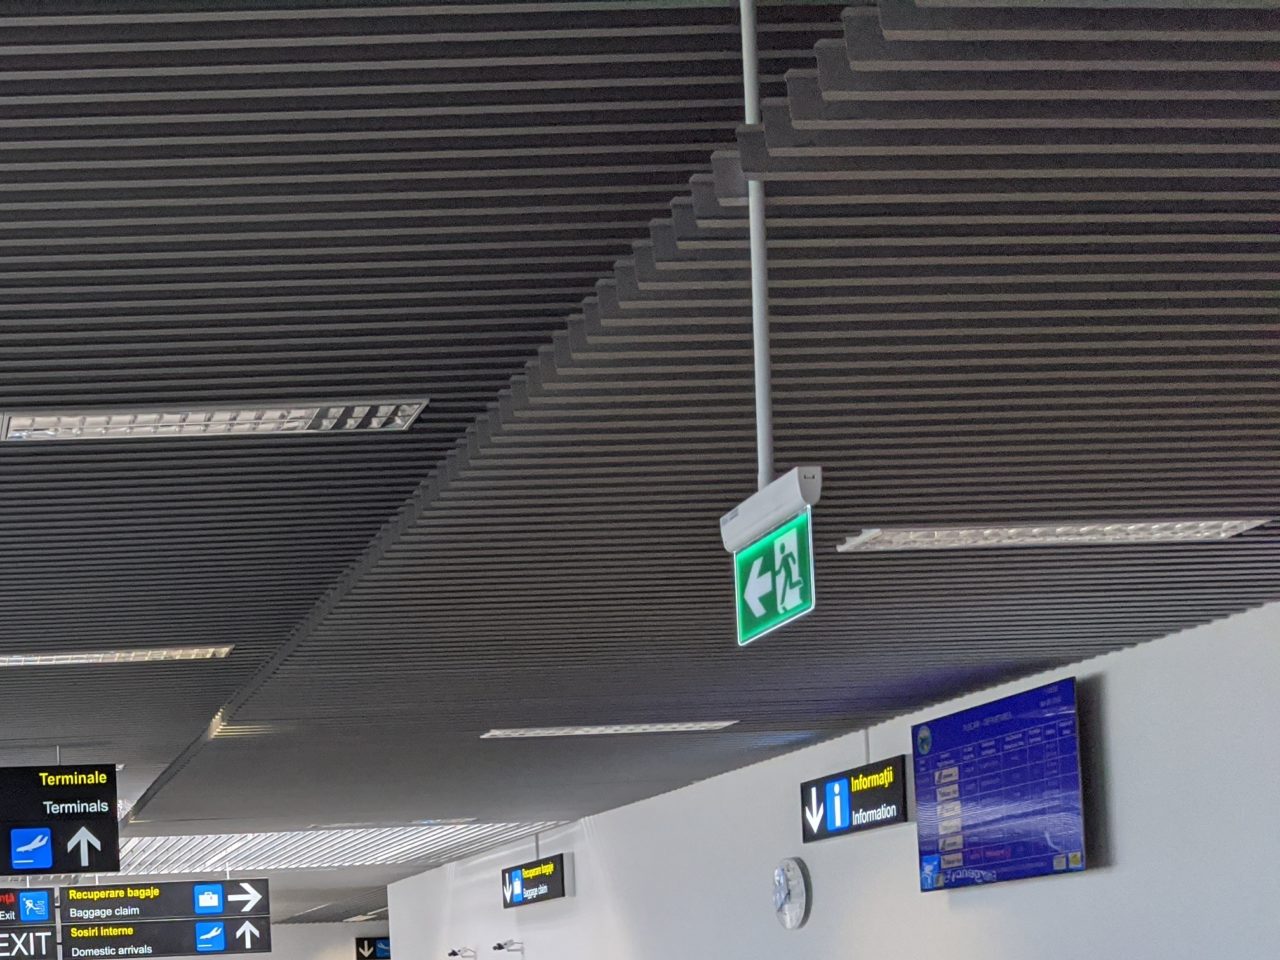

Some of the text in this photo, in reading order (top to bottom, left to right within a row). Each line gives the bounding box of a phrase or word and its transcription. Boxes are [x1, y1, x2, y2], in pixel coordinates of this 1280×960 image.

[39, 771, 108, 786] Terminale
[43, 801, 109, 814] Terminals
[852, 803, 897, 826] Information
[69, 887, 160, 901] Recuperare bagaje
[0, 911, 16, 920] Exit
[70, 906, 140, 920] Baggage claim
[70, 926, 134, 938] Sosiri interne
[71, 945, 153, 957] Domestic arrivals
